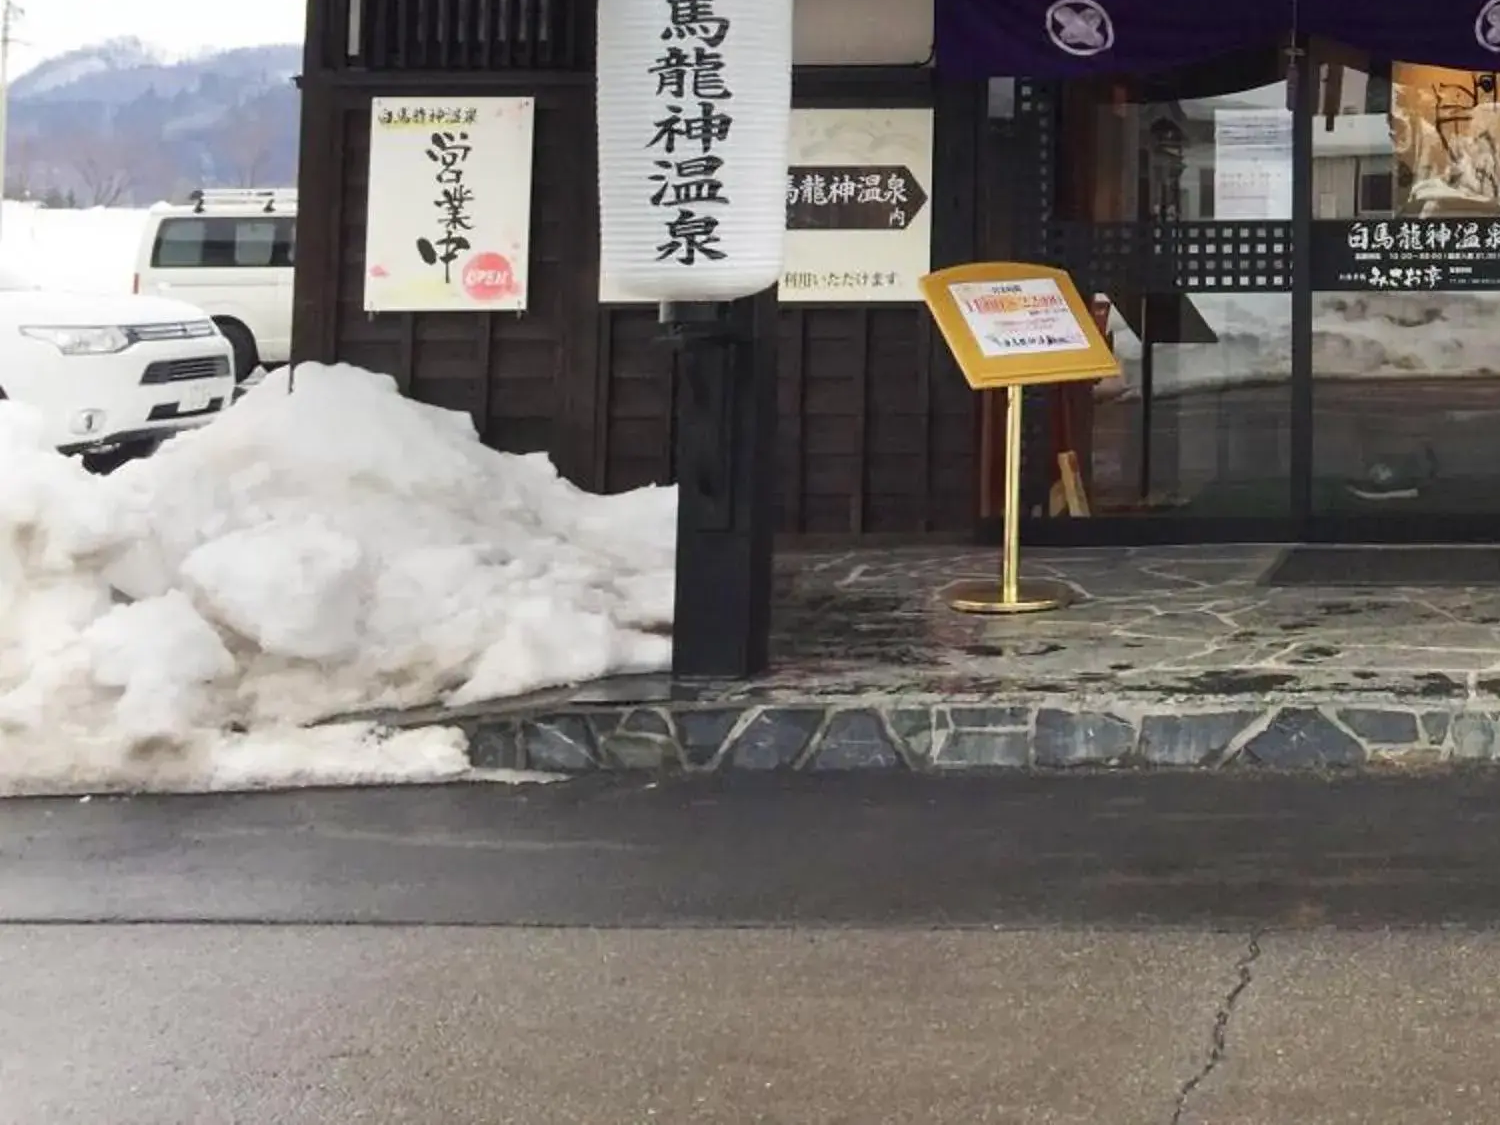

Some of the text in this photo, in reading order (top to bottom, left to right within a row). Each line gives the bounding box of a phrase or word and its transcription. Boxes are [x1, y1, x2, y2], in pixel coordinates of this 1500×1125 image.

[416, 132, 475, 283] 営業中
[465, 270, 509, 286] OPEN
